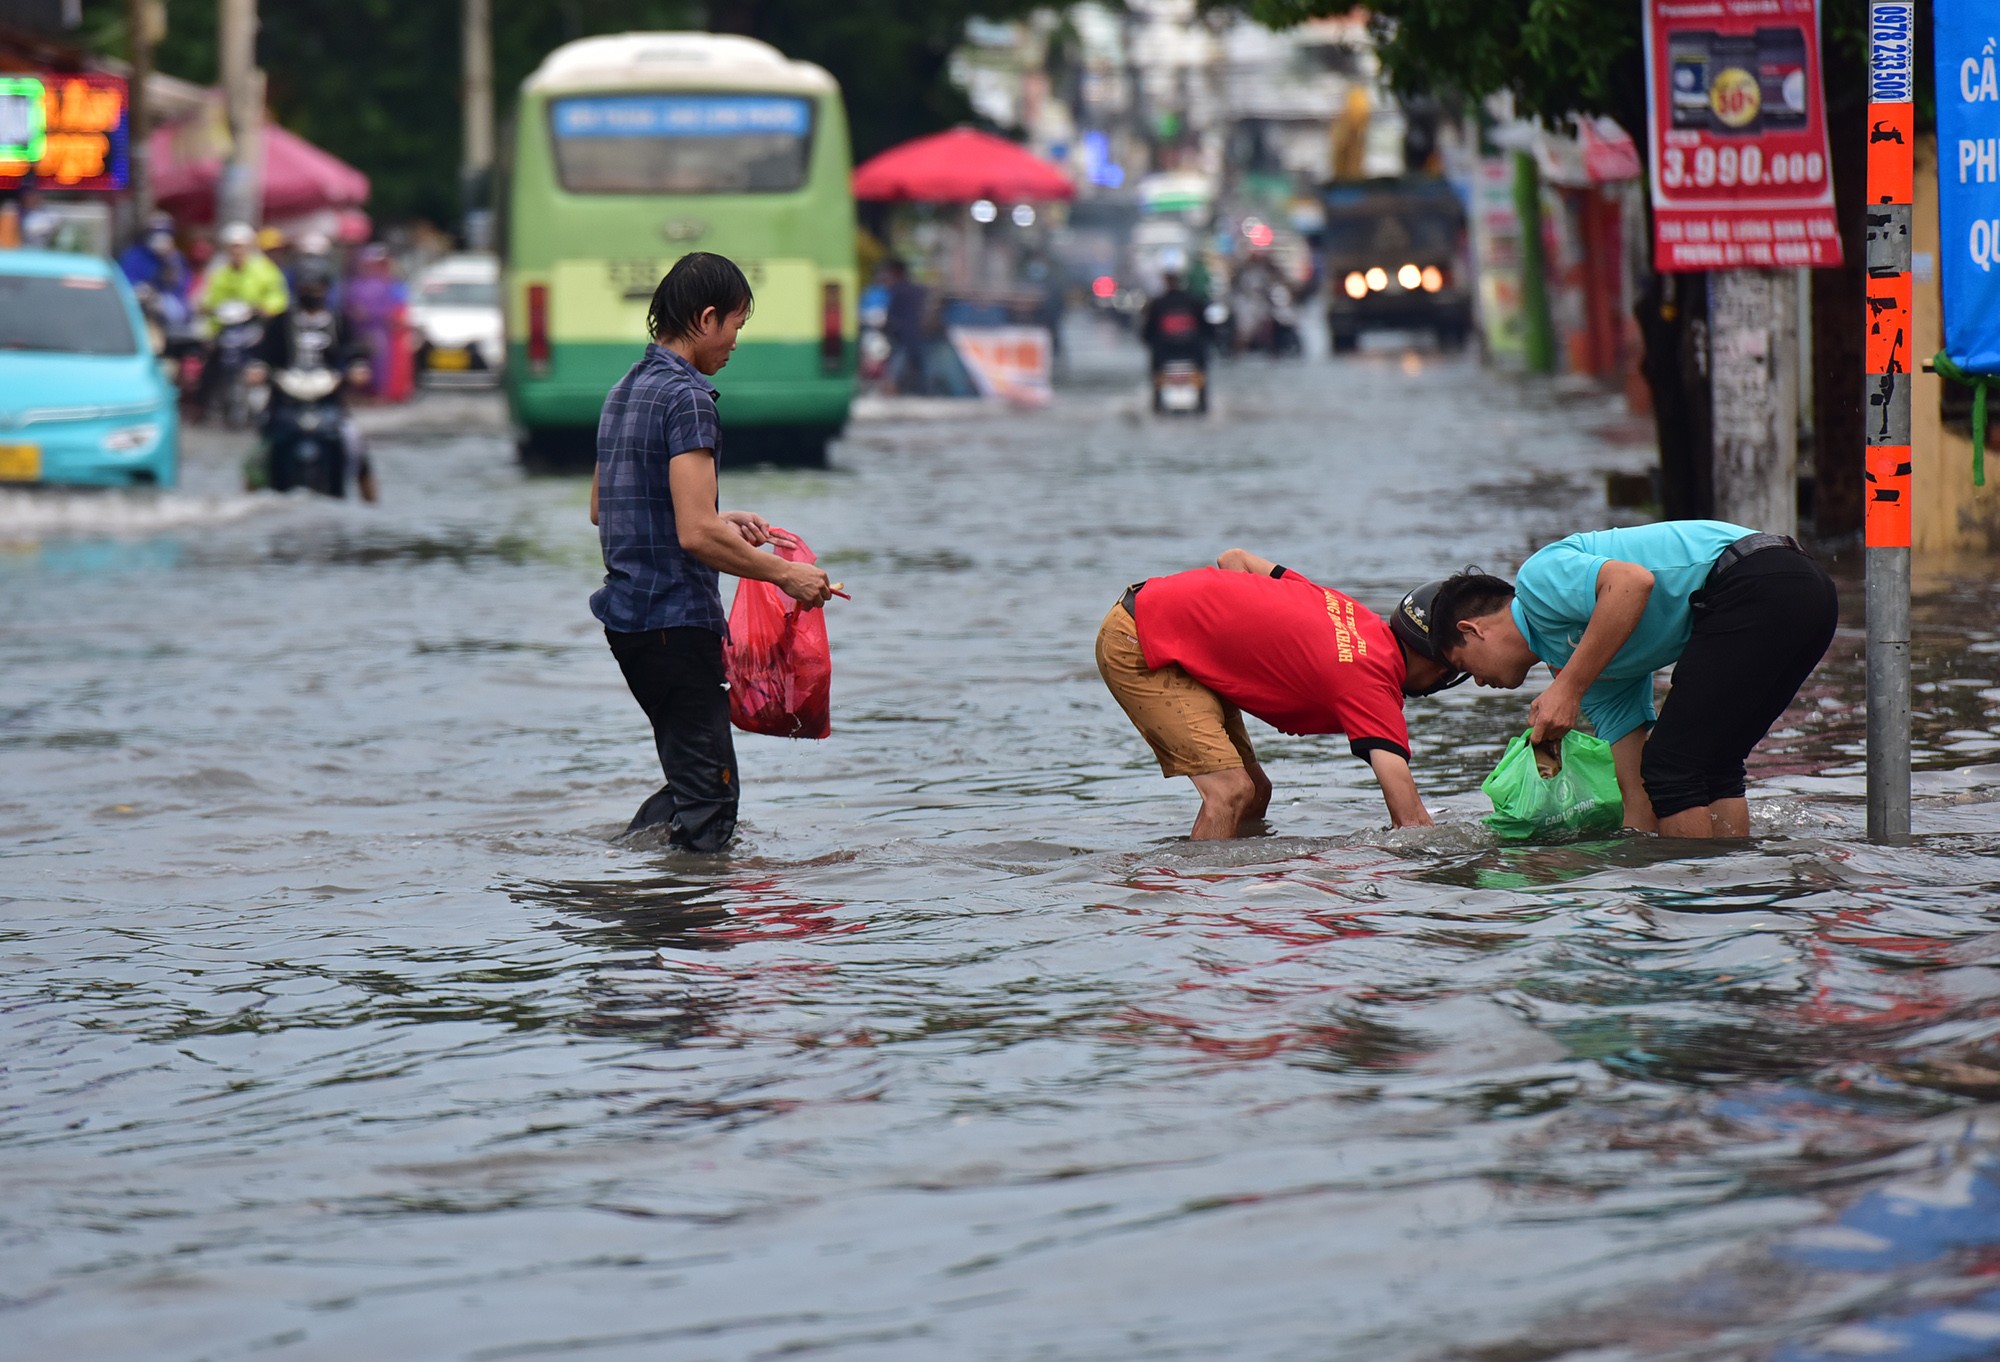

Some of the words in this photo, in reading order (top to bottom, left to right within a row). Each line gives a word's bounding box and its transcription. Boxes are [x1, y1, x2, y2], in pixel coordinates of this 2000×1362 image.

[1873, 6, 1908, 100] 0978.233.500
[1663, 145, 1824, 188] 3.990.000
[1959, 138, 2000, 184] PH
